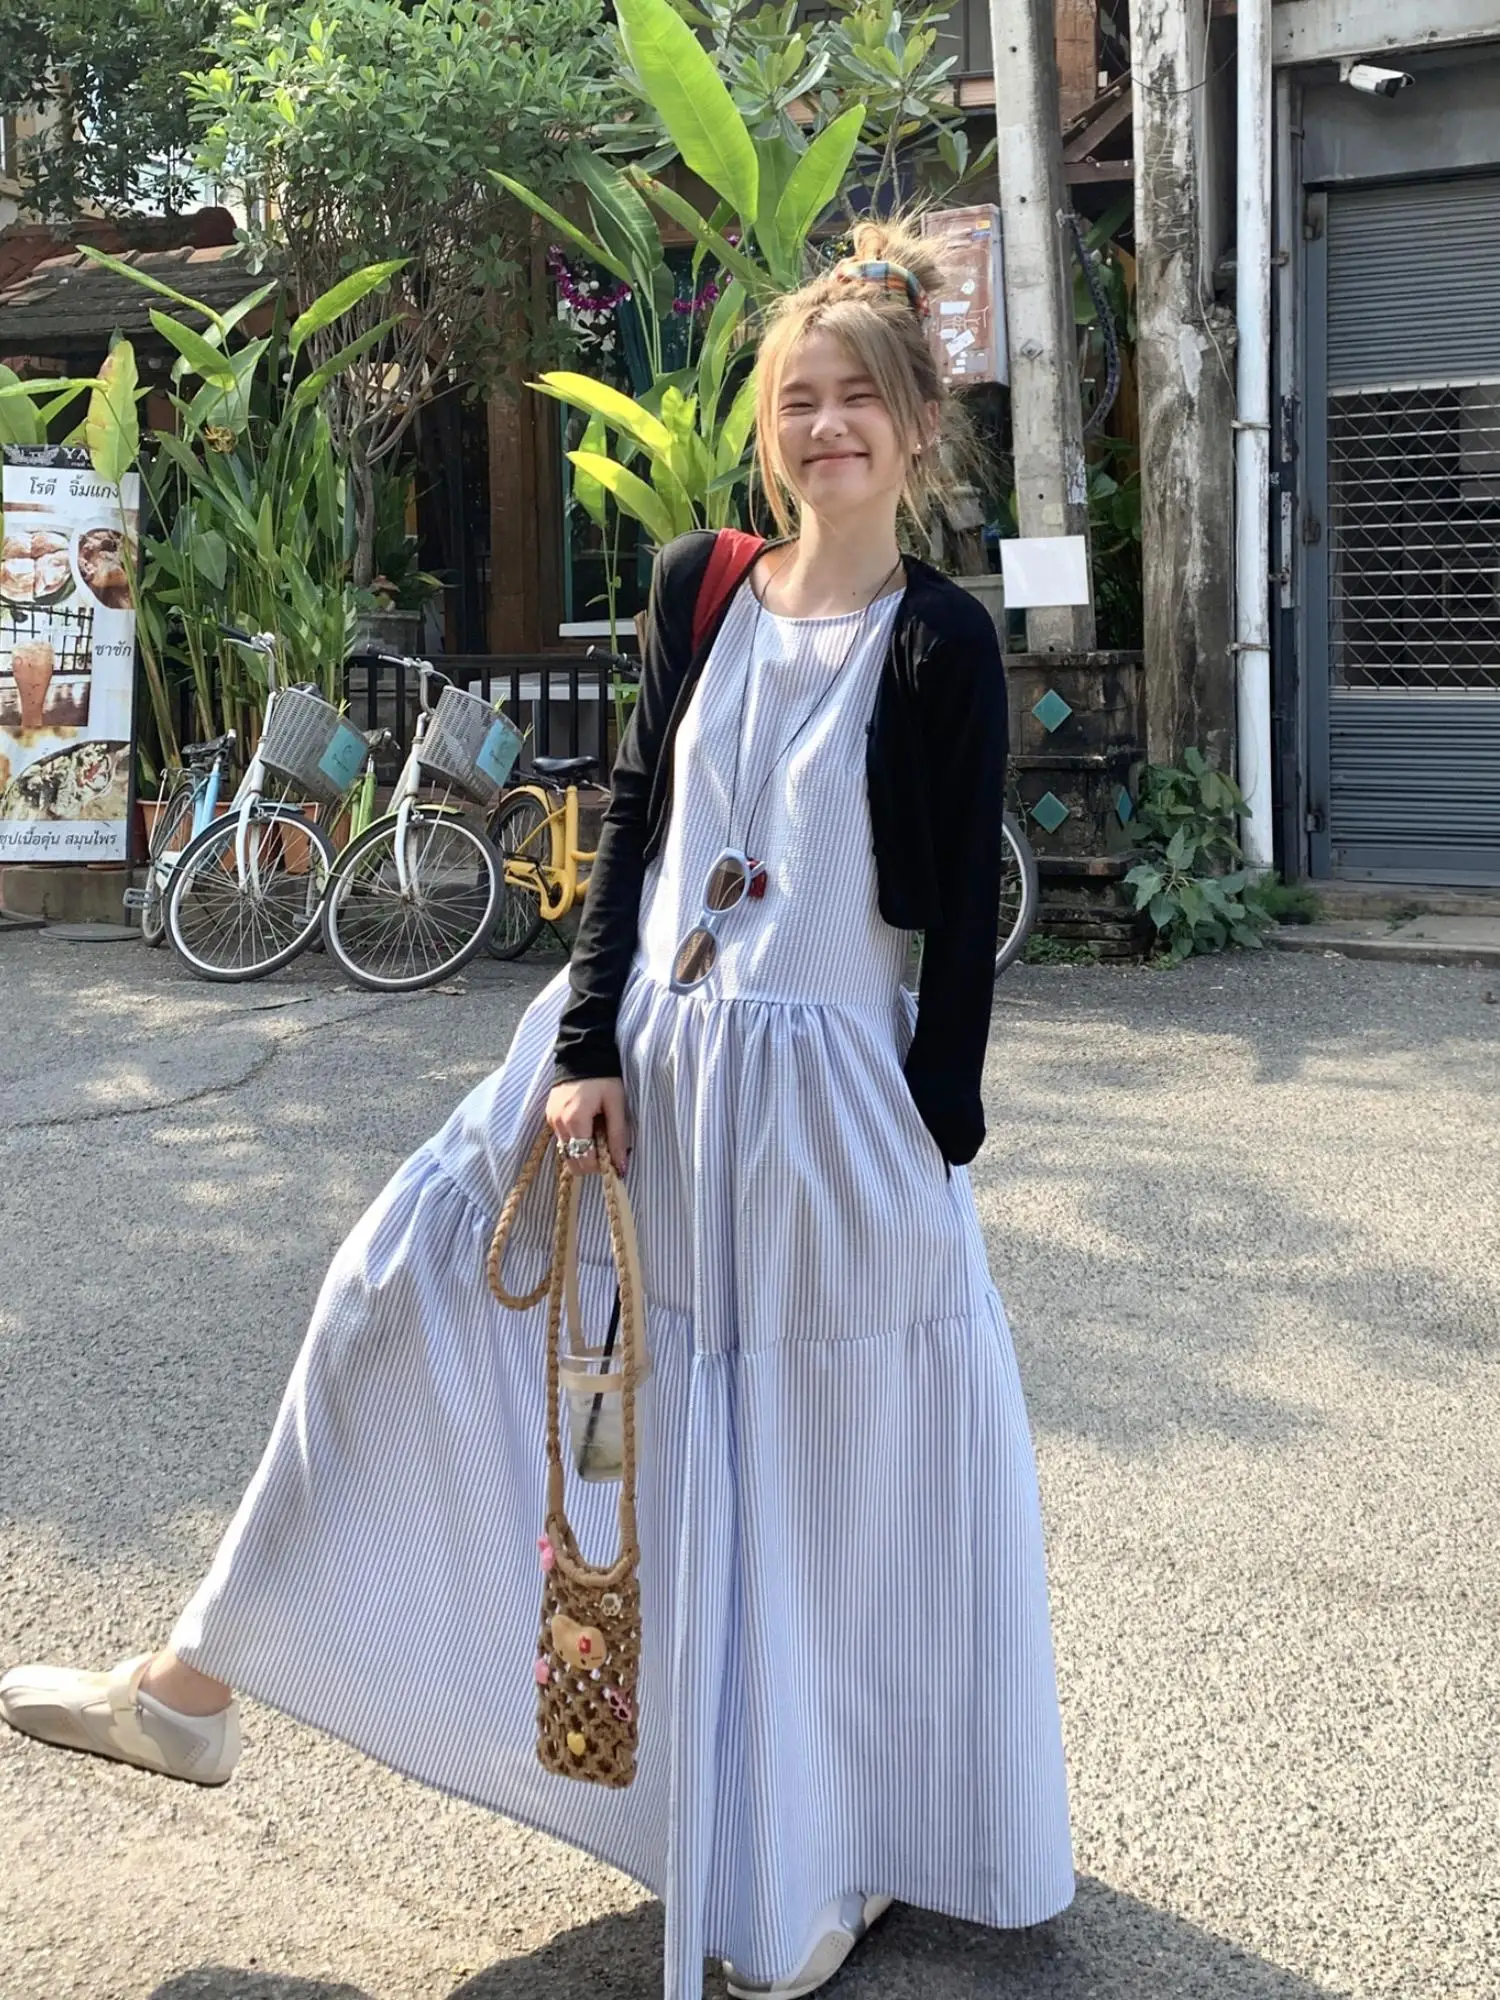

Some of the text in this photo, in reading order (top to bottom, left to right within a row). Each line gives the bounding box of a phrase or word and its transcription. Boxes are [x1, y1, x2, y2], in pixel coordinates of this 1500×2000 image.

[62, 447, 90, 461] YA
[30, 476, 57, 496] โรตี
[65, 830, 118, 850] สมุนไพร
